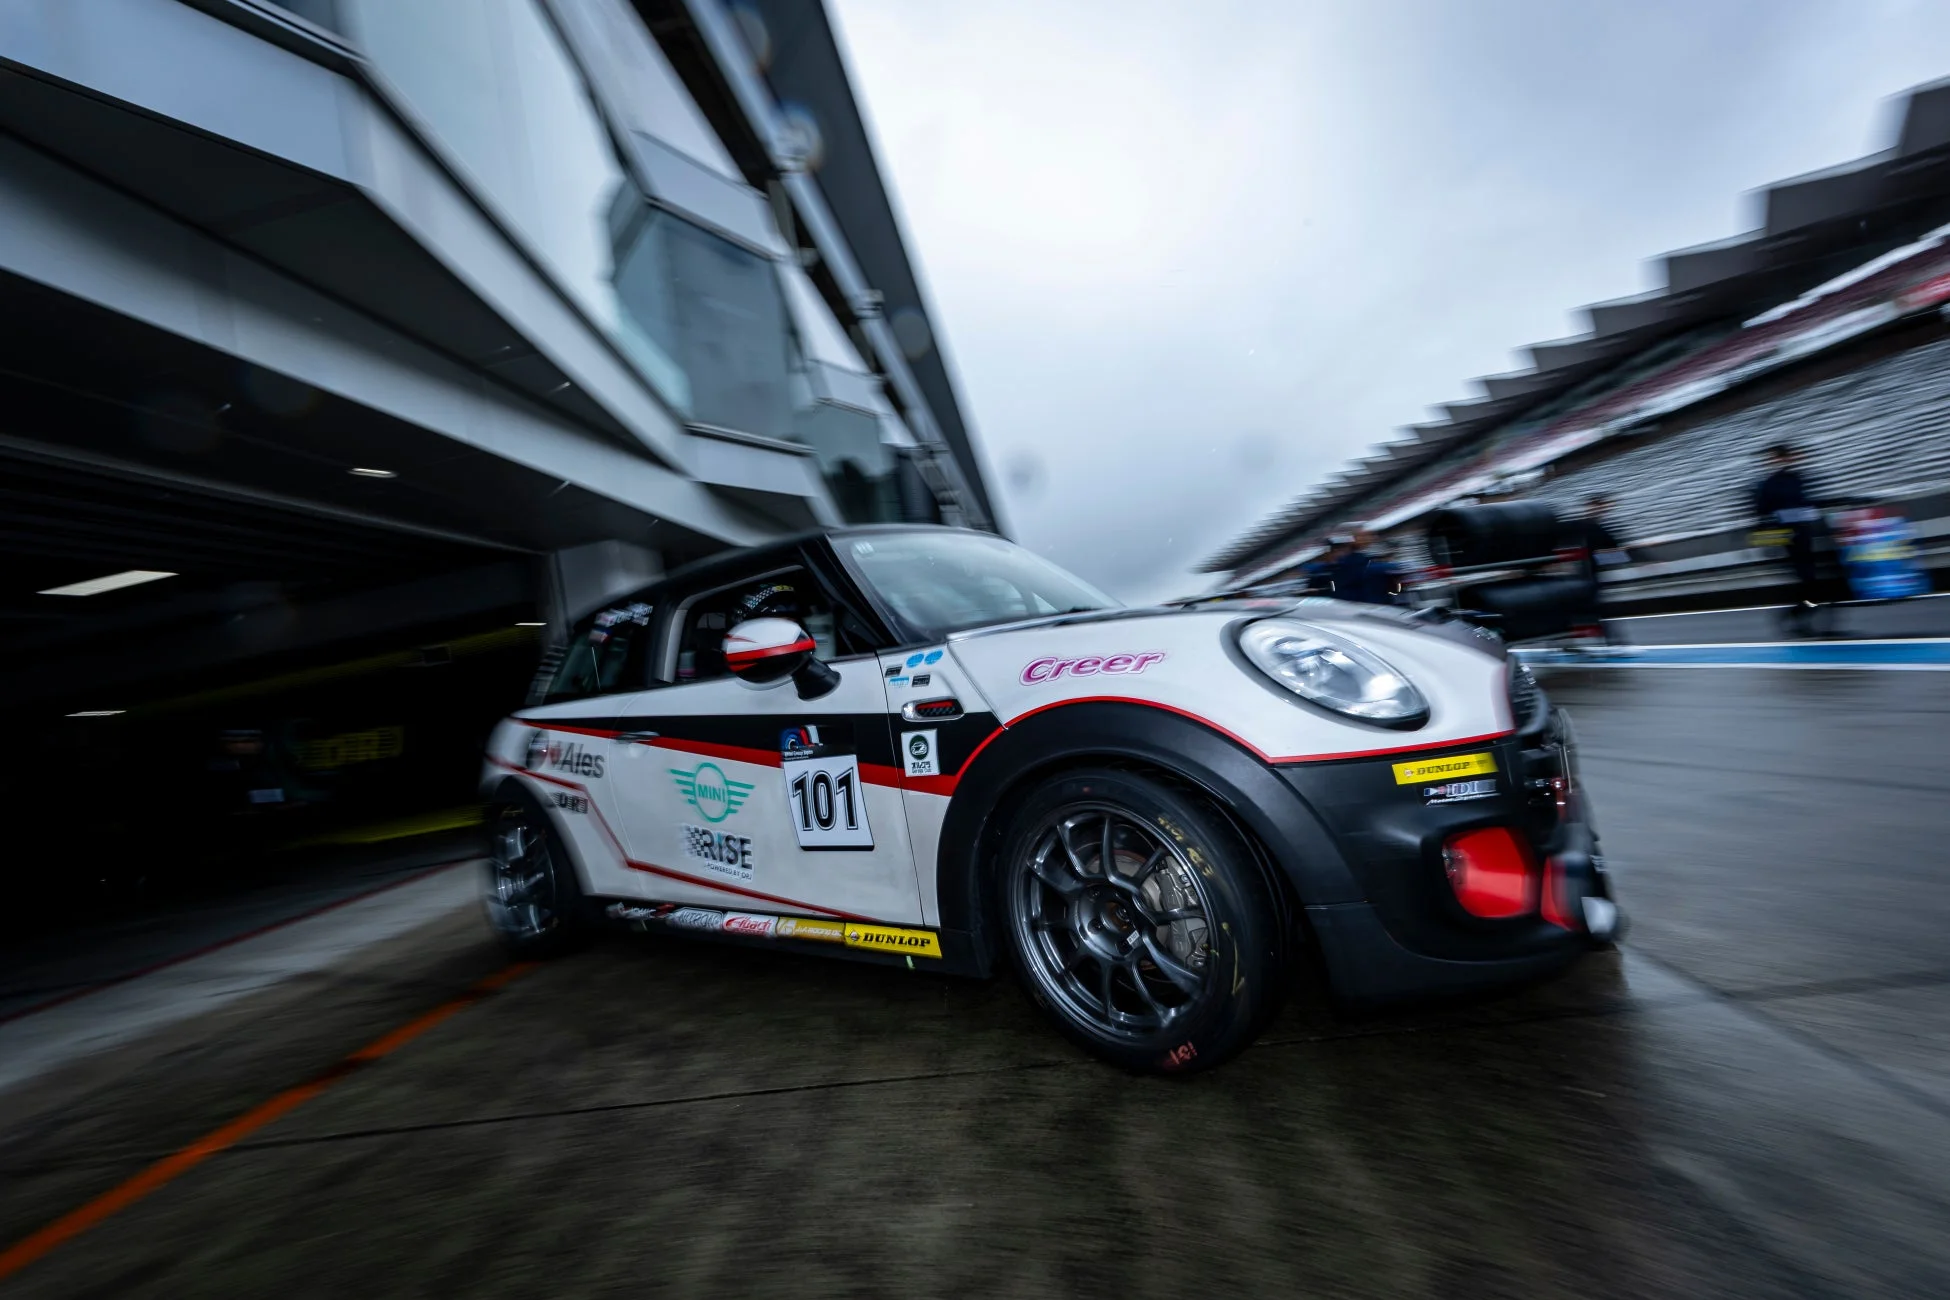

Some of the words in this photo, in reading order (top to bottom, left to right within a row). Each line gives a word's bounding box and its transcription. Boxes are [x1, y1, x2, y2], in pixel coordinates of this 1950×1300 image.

[1020, 653, 1164, 685] Creer
[1417, 762, 1470, 776] DUNLOP
[698, 783, 726, 803] MINI
[792, 767, 858, 831] 101
[702, 829, 753, 870] RISE
[862, 931, 932, 948] DUNLOP
